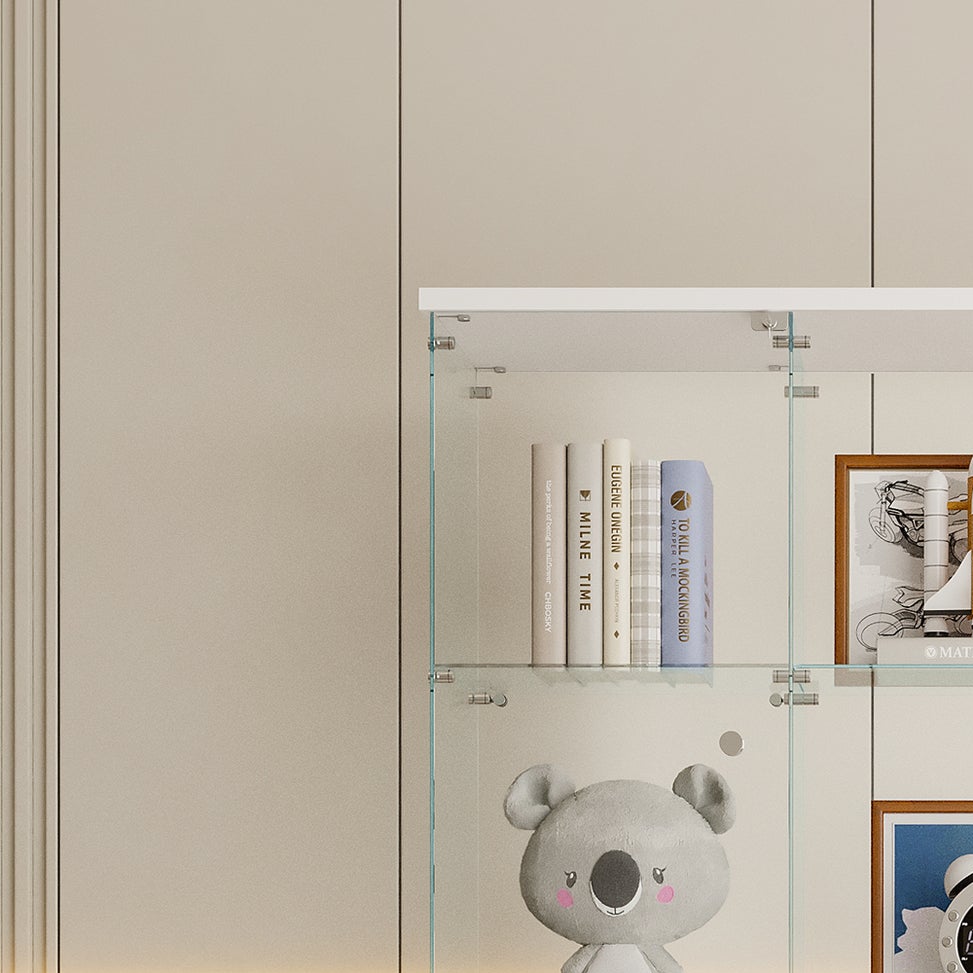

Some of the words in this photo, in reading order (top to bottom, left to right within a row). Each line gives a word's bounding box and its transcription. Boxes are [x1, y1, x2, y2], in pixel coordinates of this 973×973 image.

[611, 464, 622, 508] EUGENE
[580, 512, 591, 560] MILNE
[611, 511, 622, 553] ONEGIN
[678, 518, 690, 531] TO
[678, 535, 690, 555] KILL
[544, 592, 552, 633] CHBOSKY
[580, 574, 591, 611] TIME
[678, 568, 690, 642] MOCKINGBIRD
